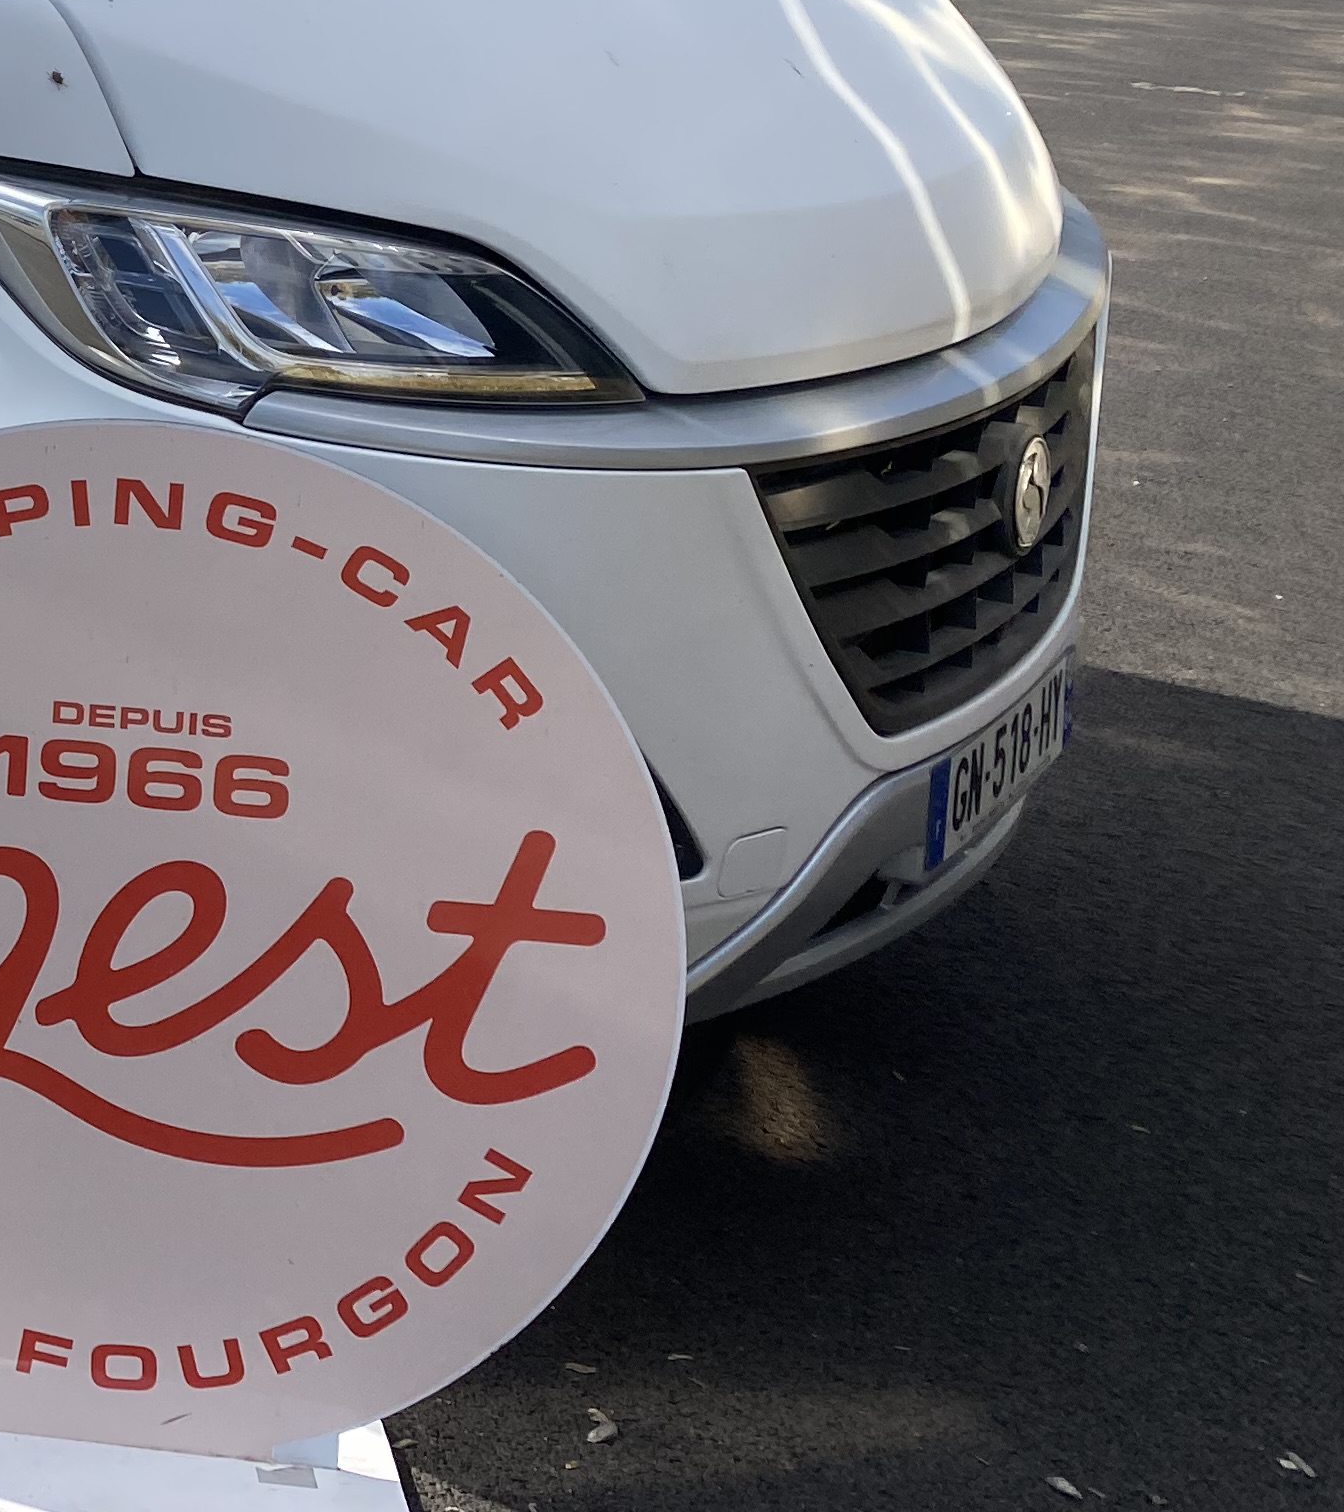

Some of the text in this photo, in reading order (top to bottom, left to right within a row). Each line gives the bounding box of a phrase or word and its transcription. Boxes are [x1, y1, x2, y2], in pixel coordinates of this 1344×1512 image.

[53, 701, 232, 738] DEPUIS
[952, 668, 1063, 832] GN-518-HY
[16, 1149, 533, 1392] FOURGON
